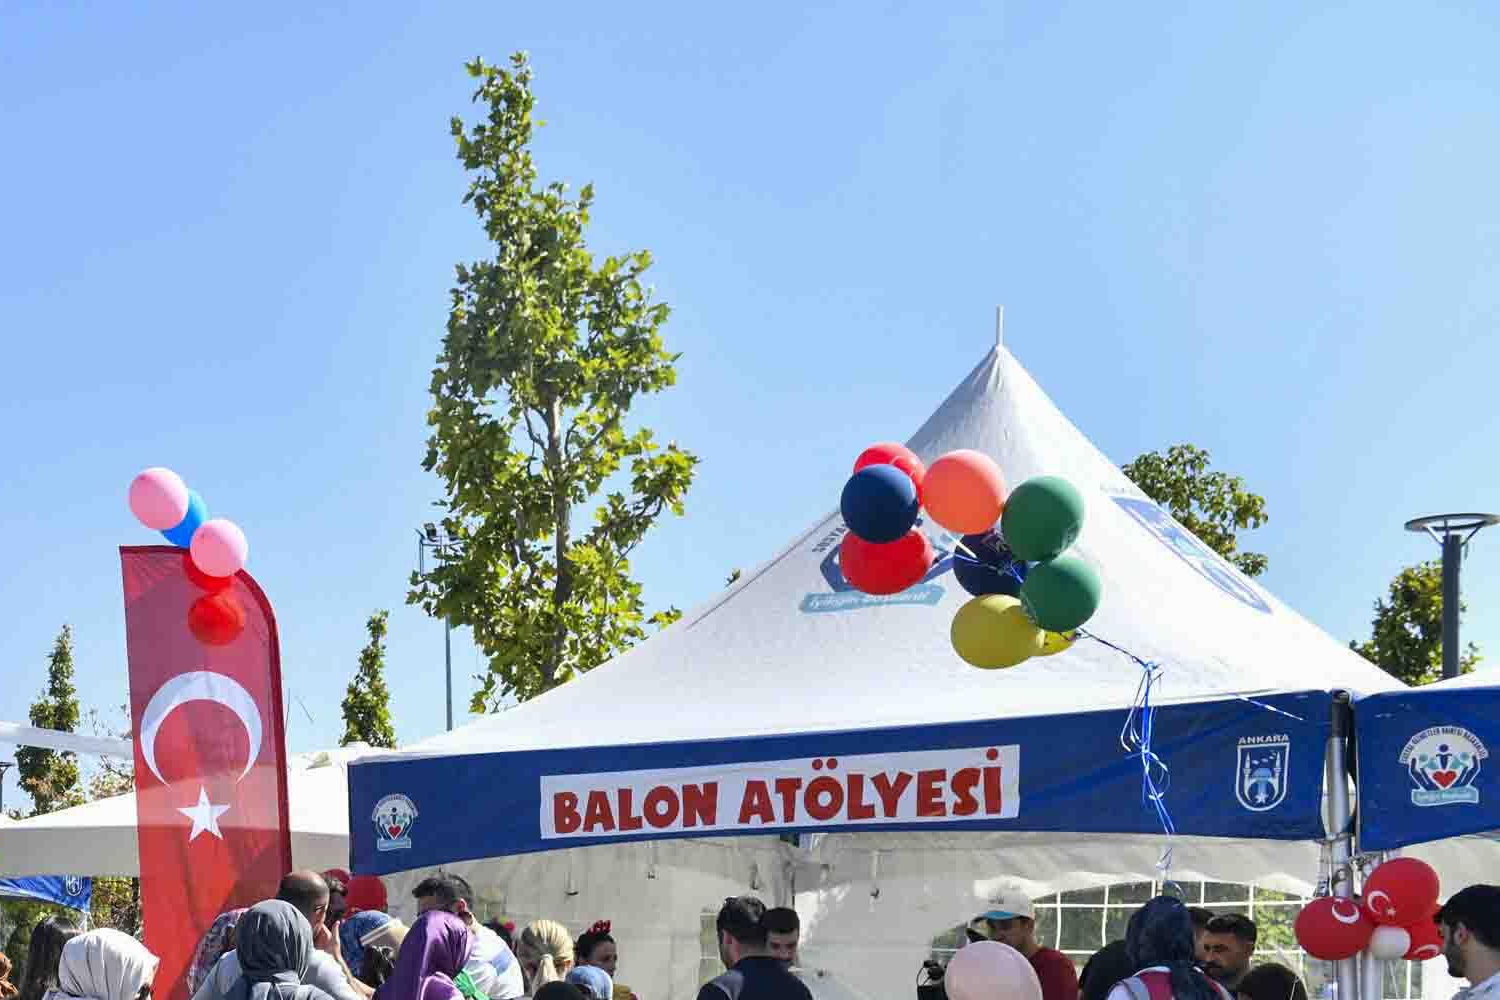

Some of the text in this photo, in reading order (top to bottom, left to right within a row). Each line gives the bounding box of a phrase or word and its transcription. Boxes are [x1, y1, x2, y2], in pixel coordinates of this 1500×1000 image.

[1238, 734, 1290, 744] ANKARA
[554, 748, 1002, 833] BALON ATÖLYESİ
